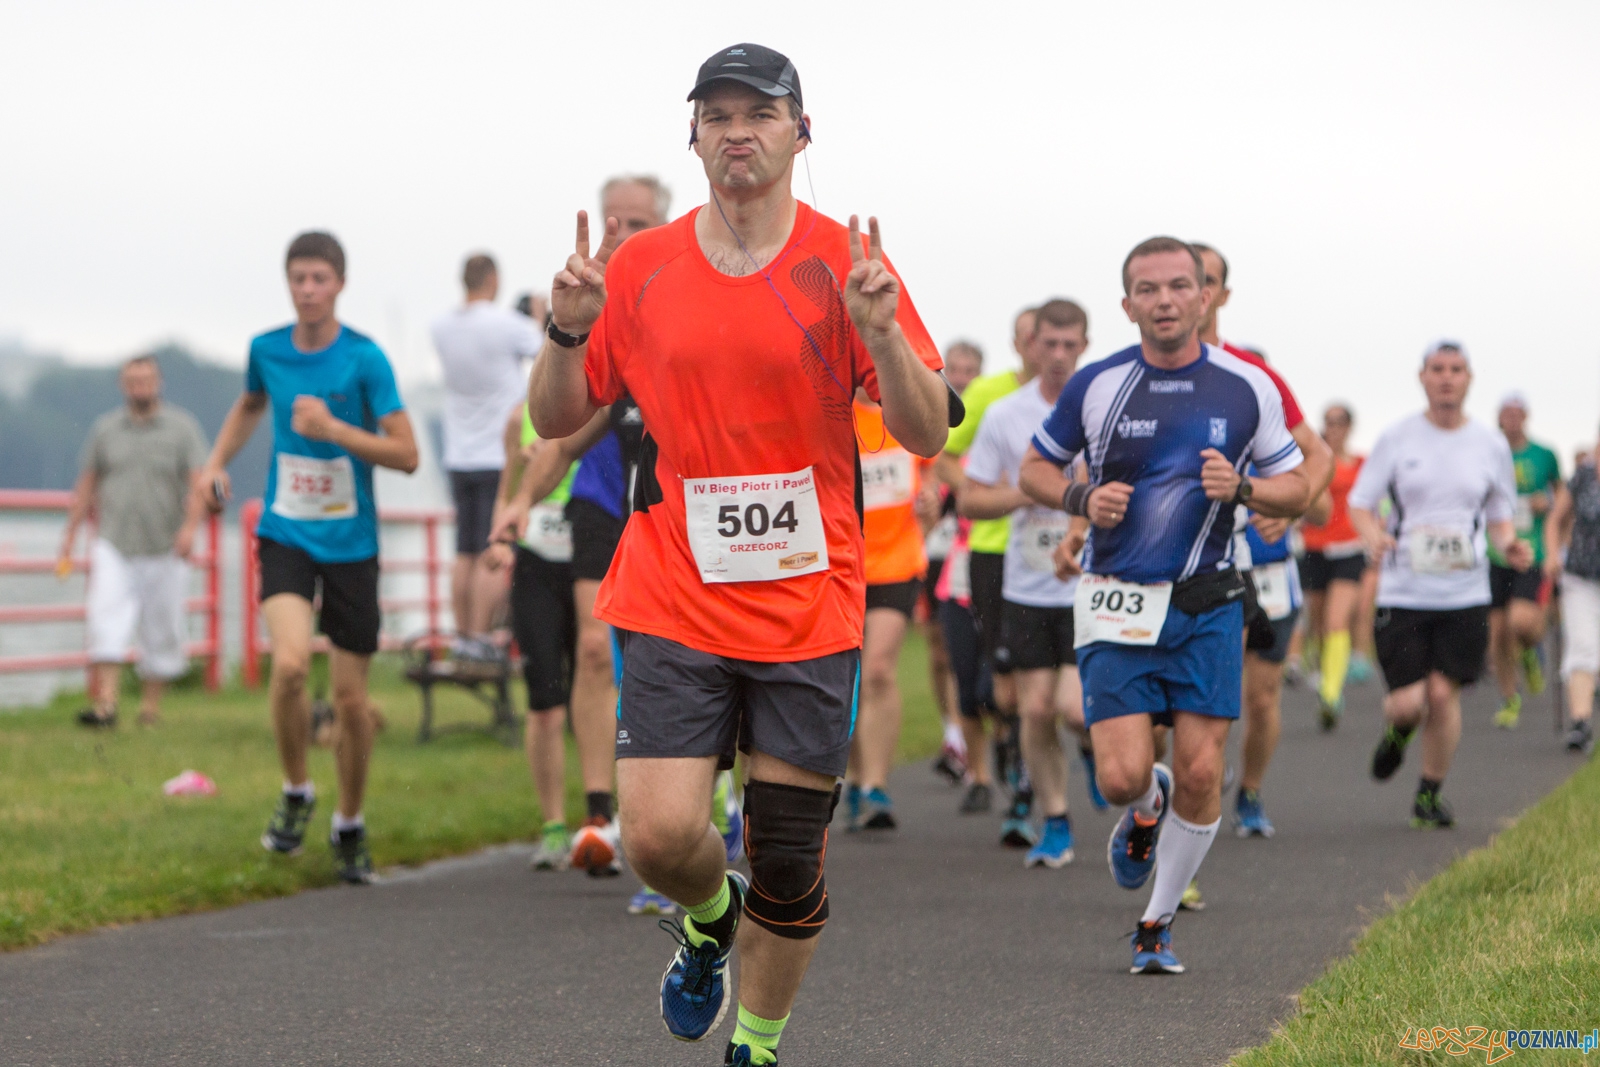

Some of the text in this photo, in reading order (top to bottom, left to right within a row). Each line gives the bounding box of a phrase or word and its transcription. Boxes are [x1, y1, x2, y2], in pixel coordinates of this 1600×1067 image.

[694, 484, 706, 494] IV
[709, 483, 738, 495] Bieg
[741, 481, 771, 492] Piotr
[775, 480, 779, 490] i
[717, 500, 799, 538] 504
[729, 541, 788, 552] GRZEGORZ
[1090, 589, 1145, 615] 903
